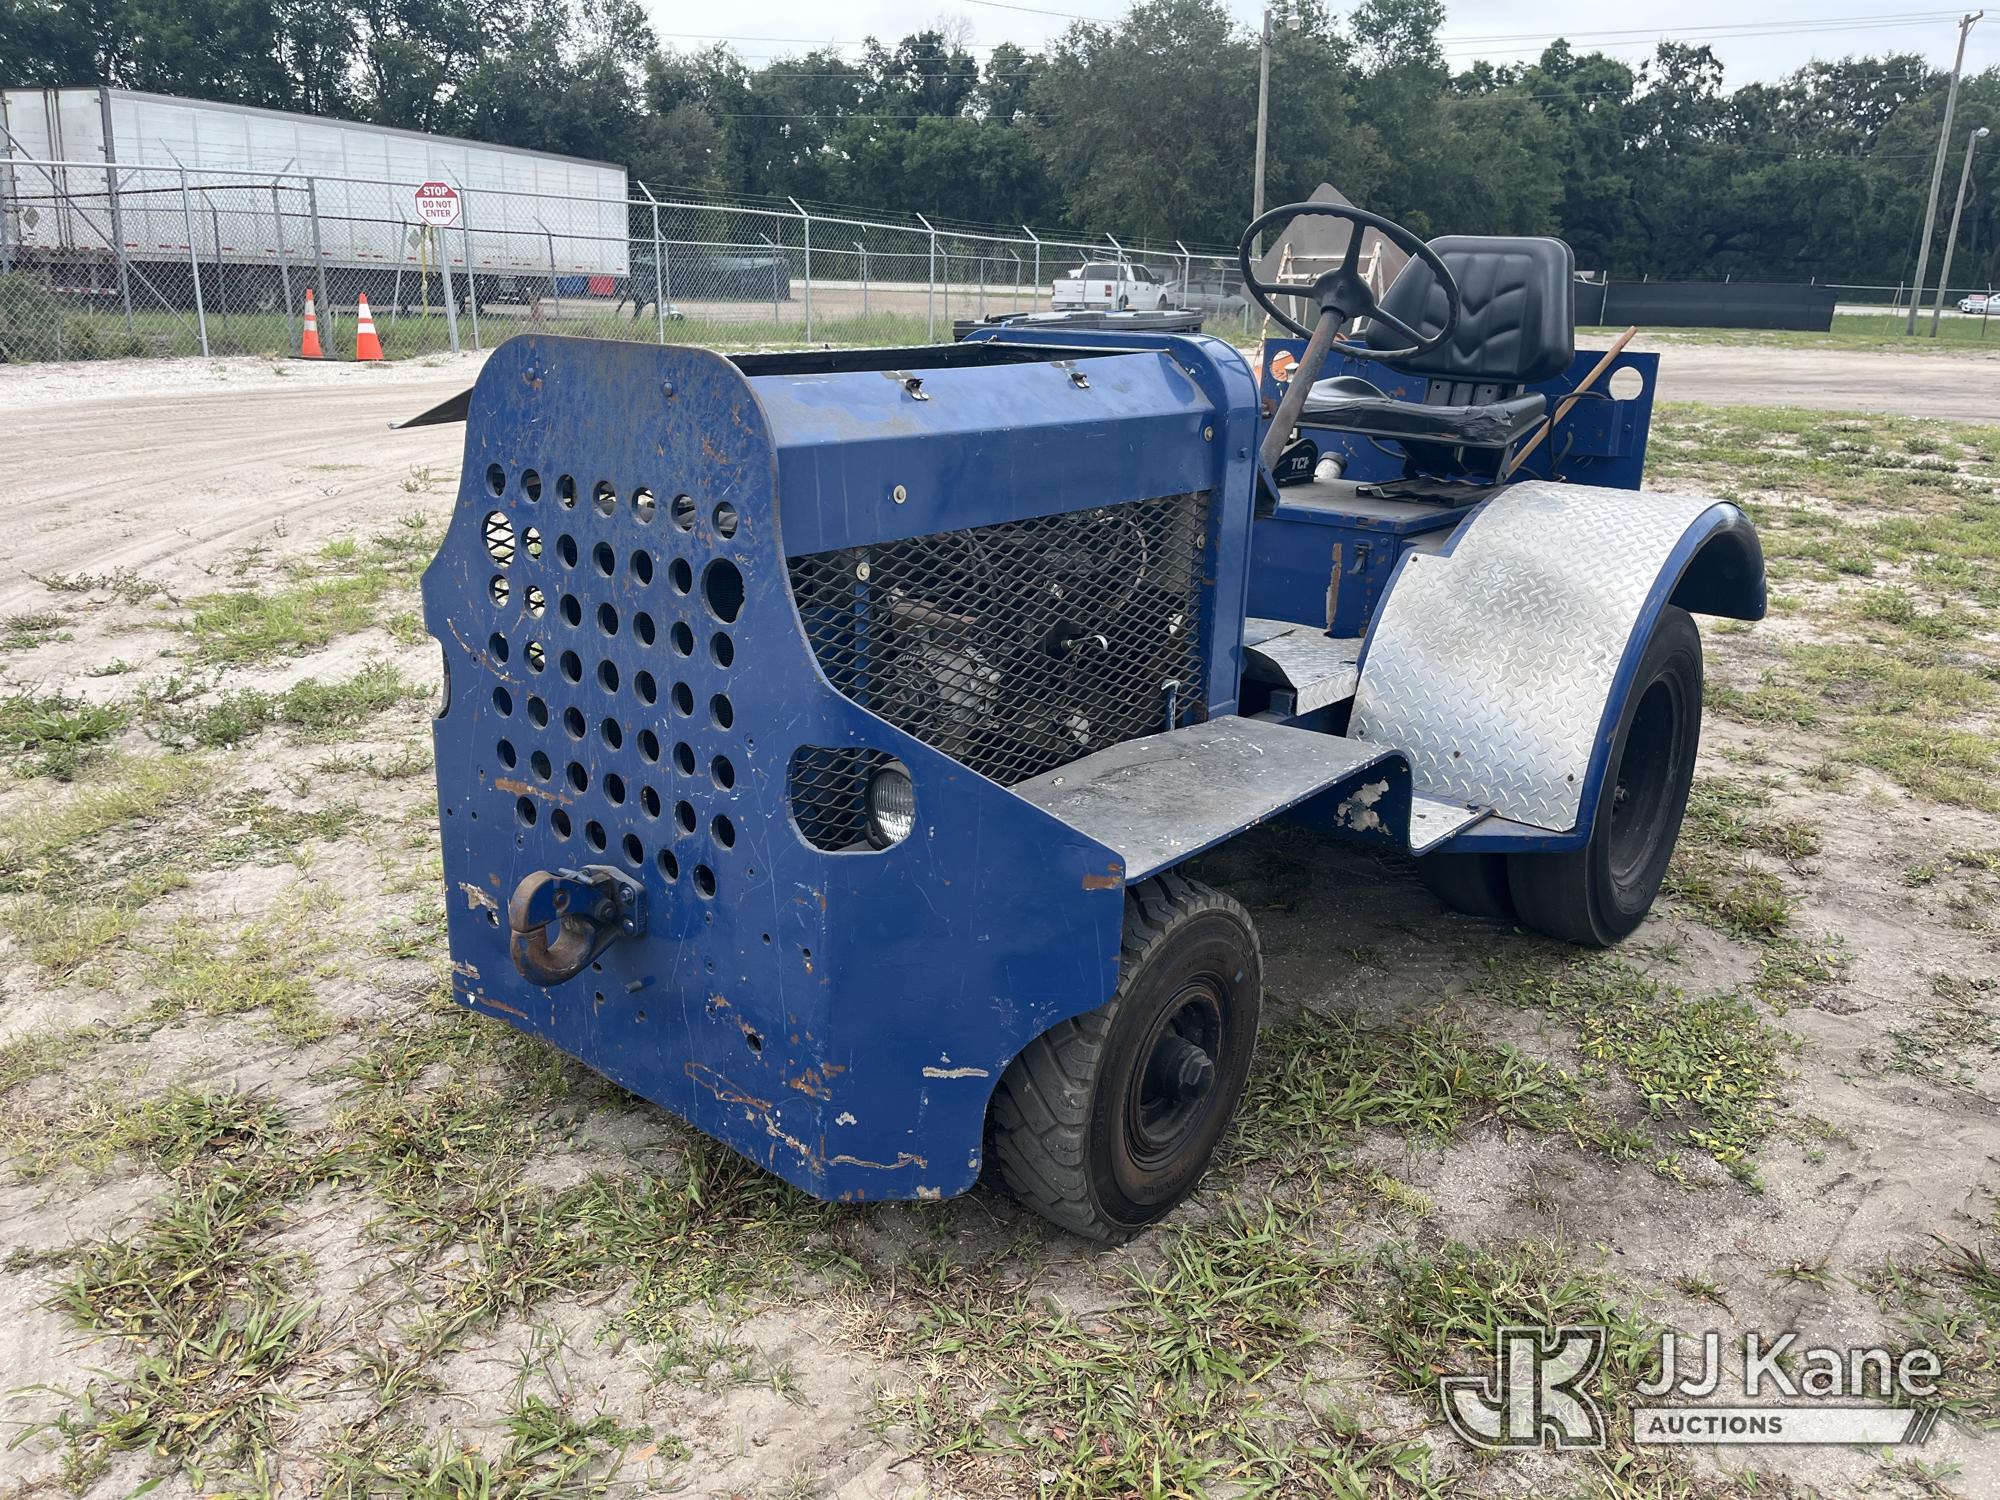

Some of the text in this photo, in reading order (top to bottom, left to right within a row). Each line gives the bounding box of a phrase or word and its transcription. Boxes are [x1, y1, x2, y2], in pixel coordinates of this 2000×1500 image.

[423, 186, 449, 196] STOP
[422, 200, 452, 208] DO NOT
[425, 209, 451, 217] ENTER
